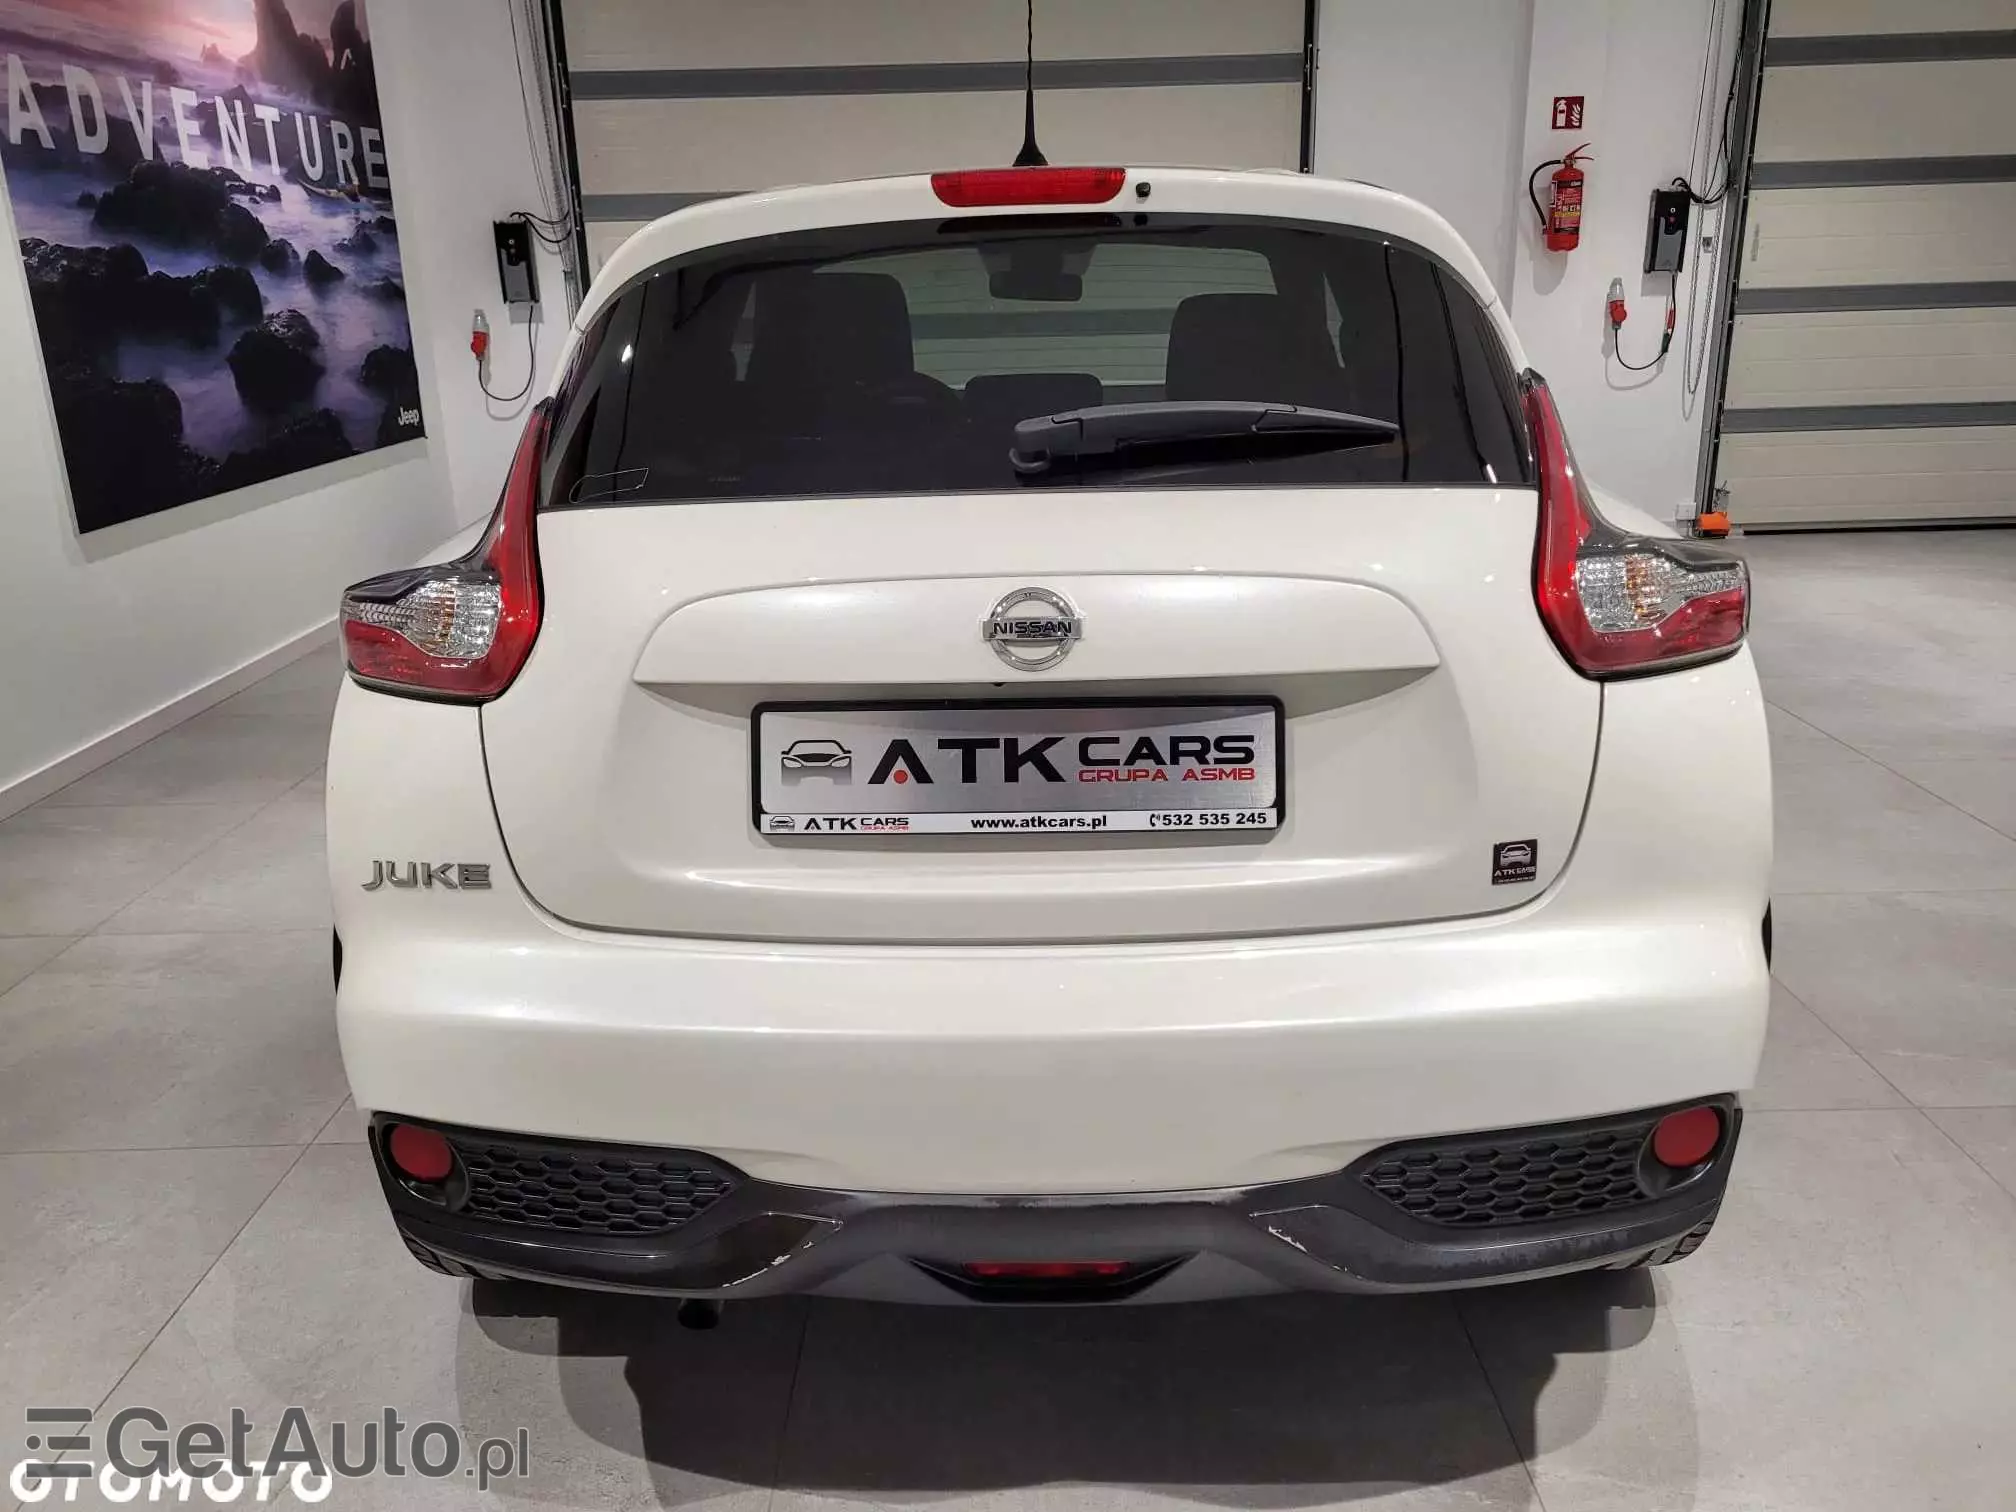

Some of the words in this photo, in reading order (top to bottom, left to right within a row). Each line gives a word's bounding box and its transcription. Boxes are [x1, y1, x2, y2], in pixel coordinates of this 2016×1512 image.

[6, 53, 389, 190] ADVENTURE
[398, 406, 420, 426] Jeep
[993, 621, 1072, 635] NISSAN
[867, 736, 1066, 784] ATK
[1077, 735, 1255, 766] CARS
[1078, 768, 1169, 783] GRUPA
[1181, 767, 1256, 781] ASMB
[804, 817, 857, 830] ATK
[860, 817, 909, 826] CARS
[971, 815, 1107, 829] www.atkcars.pl
[1162, 813, 1194, 826] 532
[1199, 813, 1231, 826] 535
[1236, 812, 1267, 825] 245
[361, 860, 492, 891] JUKE
